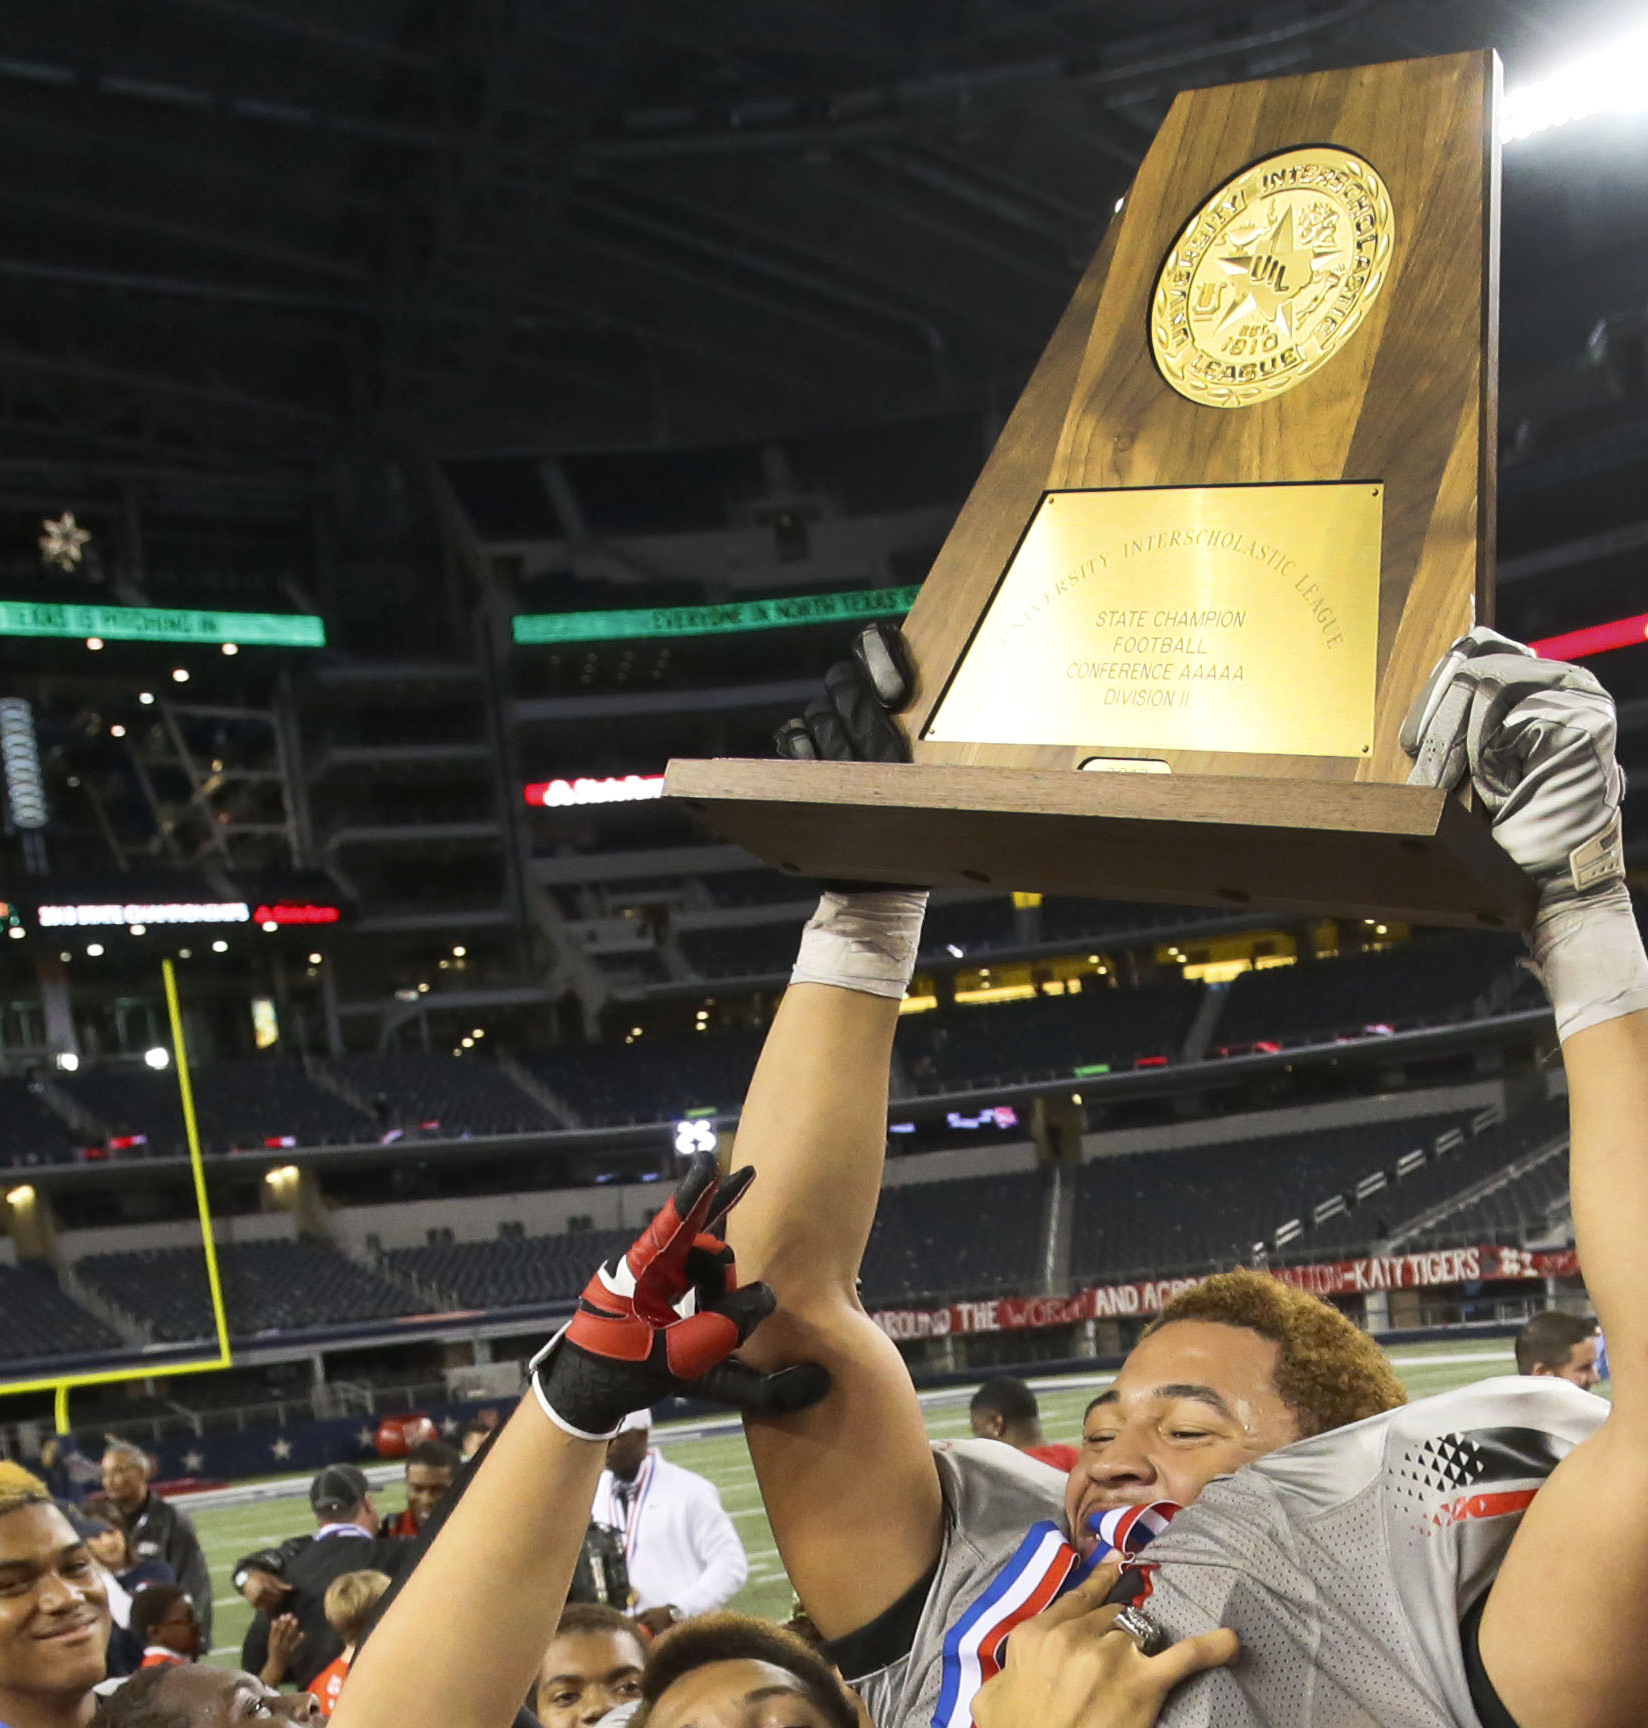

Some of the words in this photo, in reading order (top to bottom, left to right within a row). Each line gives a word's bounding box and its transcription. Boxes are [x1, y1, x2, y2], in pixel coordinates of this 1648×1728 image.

[1251, 254, 1290, 292] UIL
[1222, 332, 1280, 357] 1910
[1190, 346, 1298, 384] LEAGUE
[1122, 527, 1296, 577] INTERSCHOLASTIC
[1294, 572, 1345, 651] LEAGUE
[1096, 610, 1149, 629] STATE
[1152, 610, 1247, 629] CHAMPION
[1113, 636, 1209, 655] FOOTBALL
[1067, 661, 1174, 681] CONFERENCE
[1178, 663, 1245, 682] AAAAA
[1104, 688, 1176, 708] DIVISION
[955, 1300, 1002, 1333] THE
[1094, 1284, 1140, 1317] AND
[1408, 1249, 1481, 1286] TIGERS
